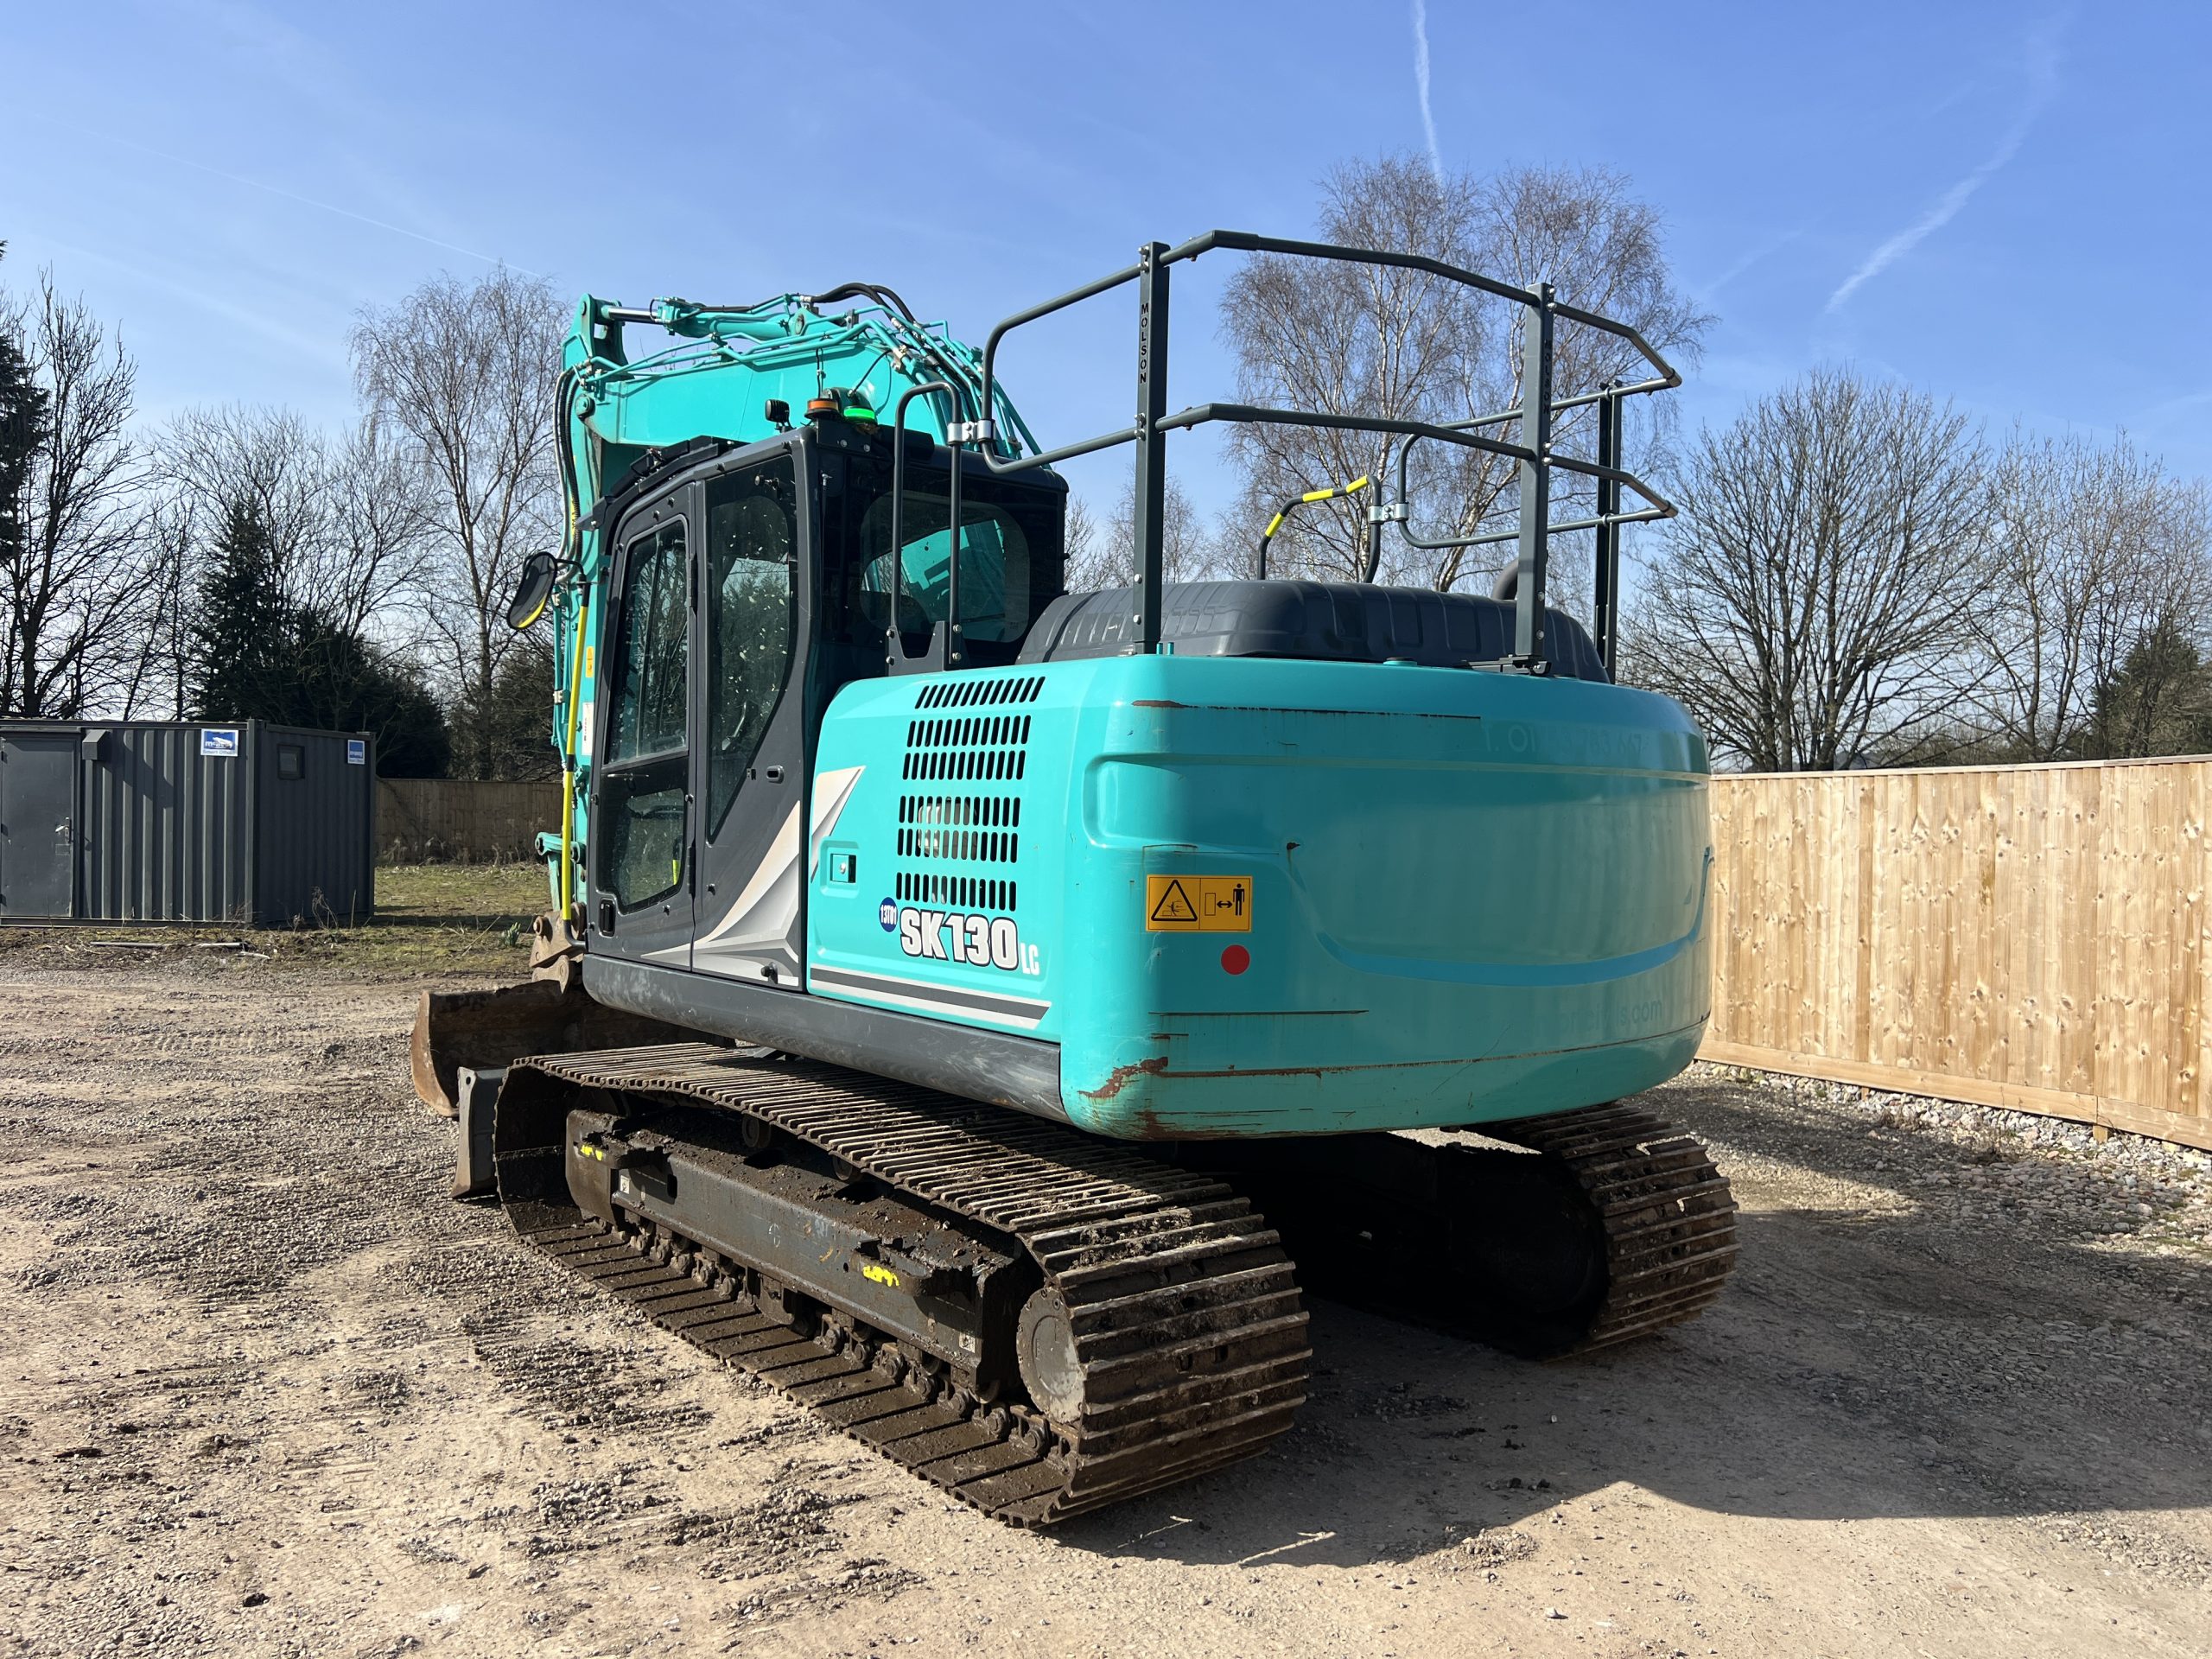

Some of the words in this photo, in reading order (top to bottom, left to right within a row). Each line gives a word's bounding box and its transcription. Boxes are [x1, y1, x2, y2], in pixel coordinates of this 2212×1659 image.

[1543, 340, 1552, 414] MOLSON
[880, 905, 897, 925] 13T01
[900, 907, 1019, 970] SK130
[1020, 943, 1039, 976] LC
